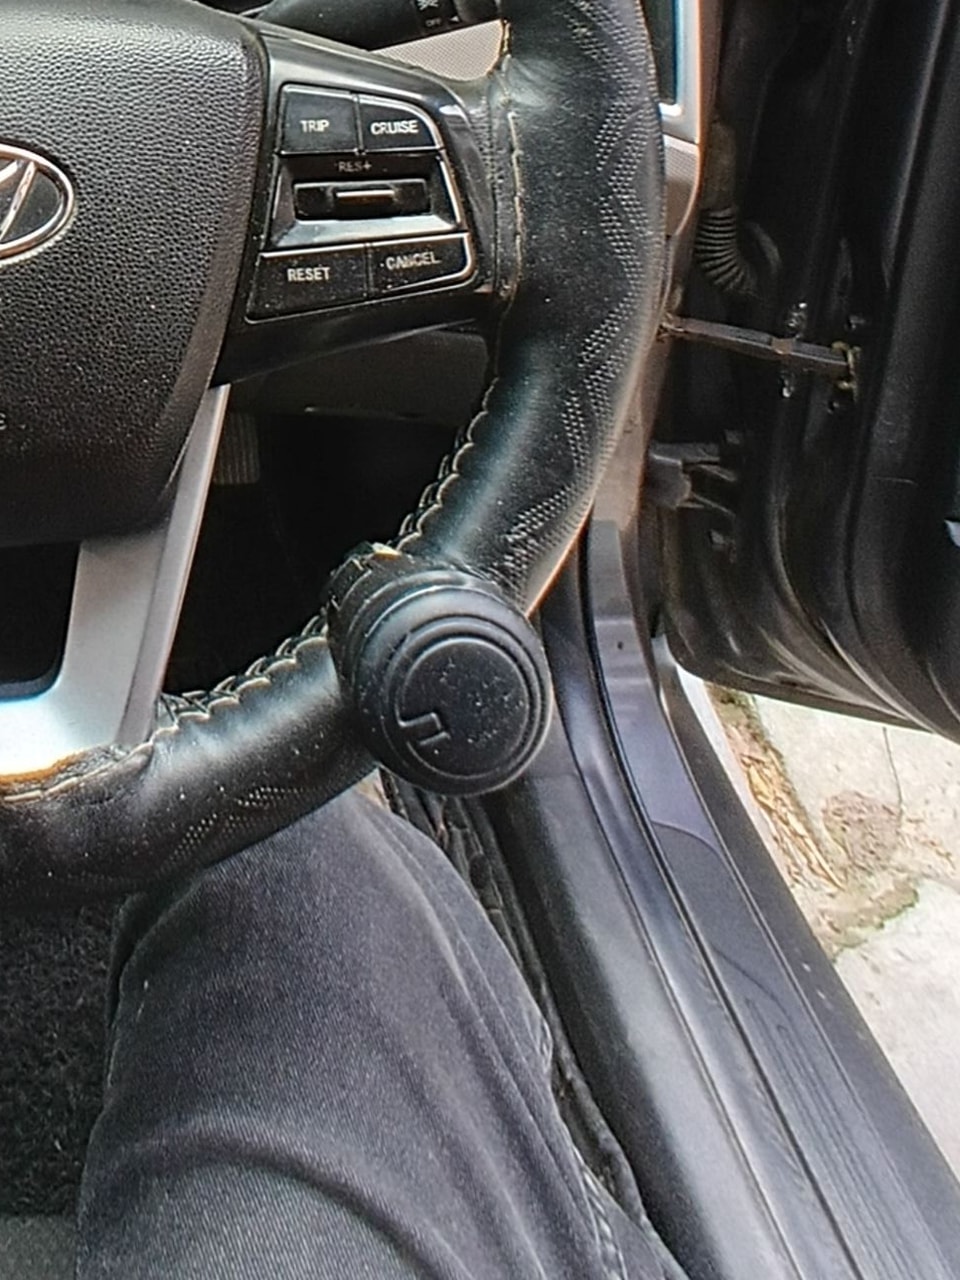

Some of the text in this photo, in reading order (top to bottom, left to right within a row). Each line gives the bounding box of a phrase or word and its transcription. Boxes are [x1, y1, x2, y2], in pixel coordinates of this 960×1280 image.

[300, 119, 420, 135] TRIP CRUISE
[287, 251, 441, 282] RESET CANCEL
